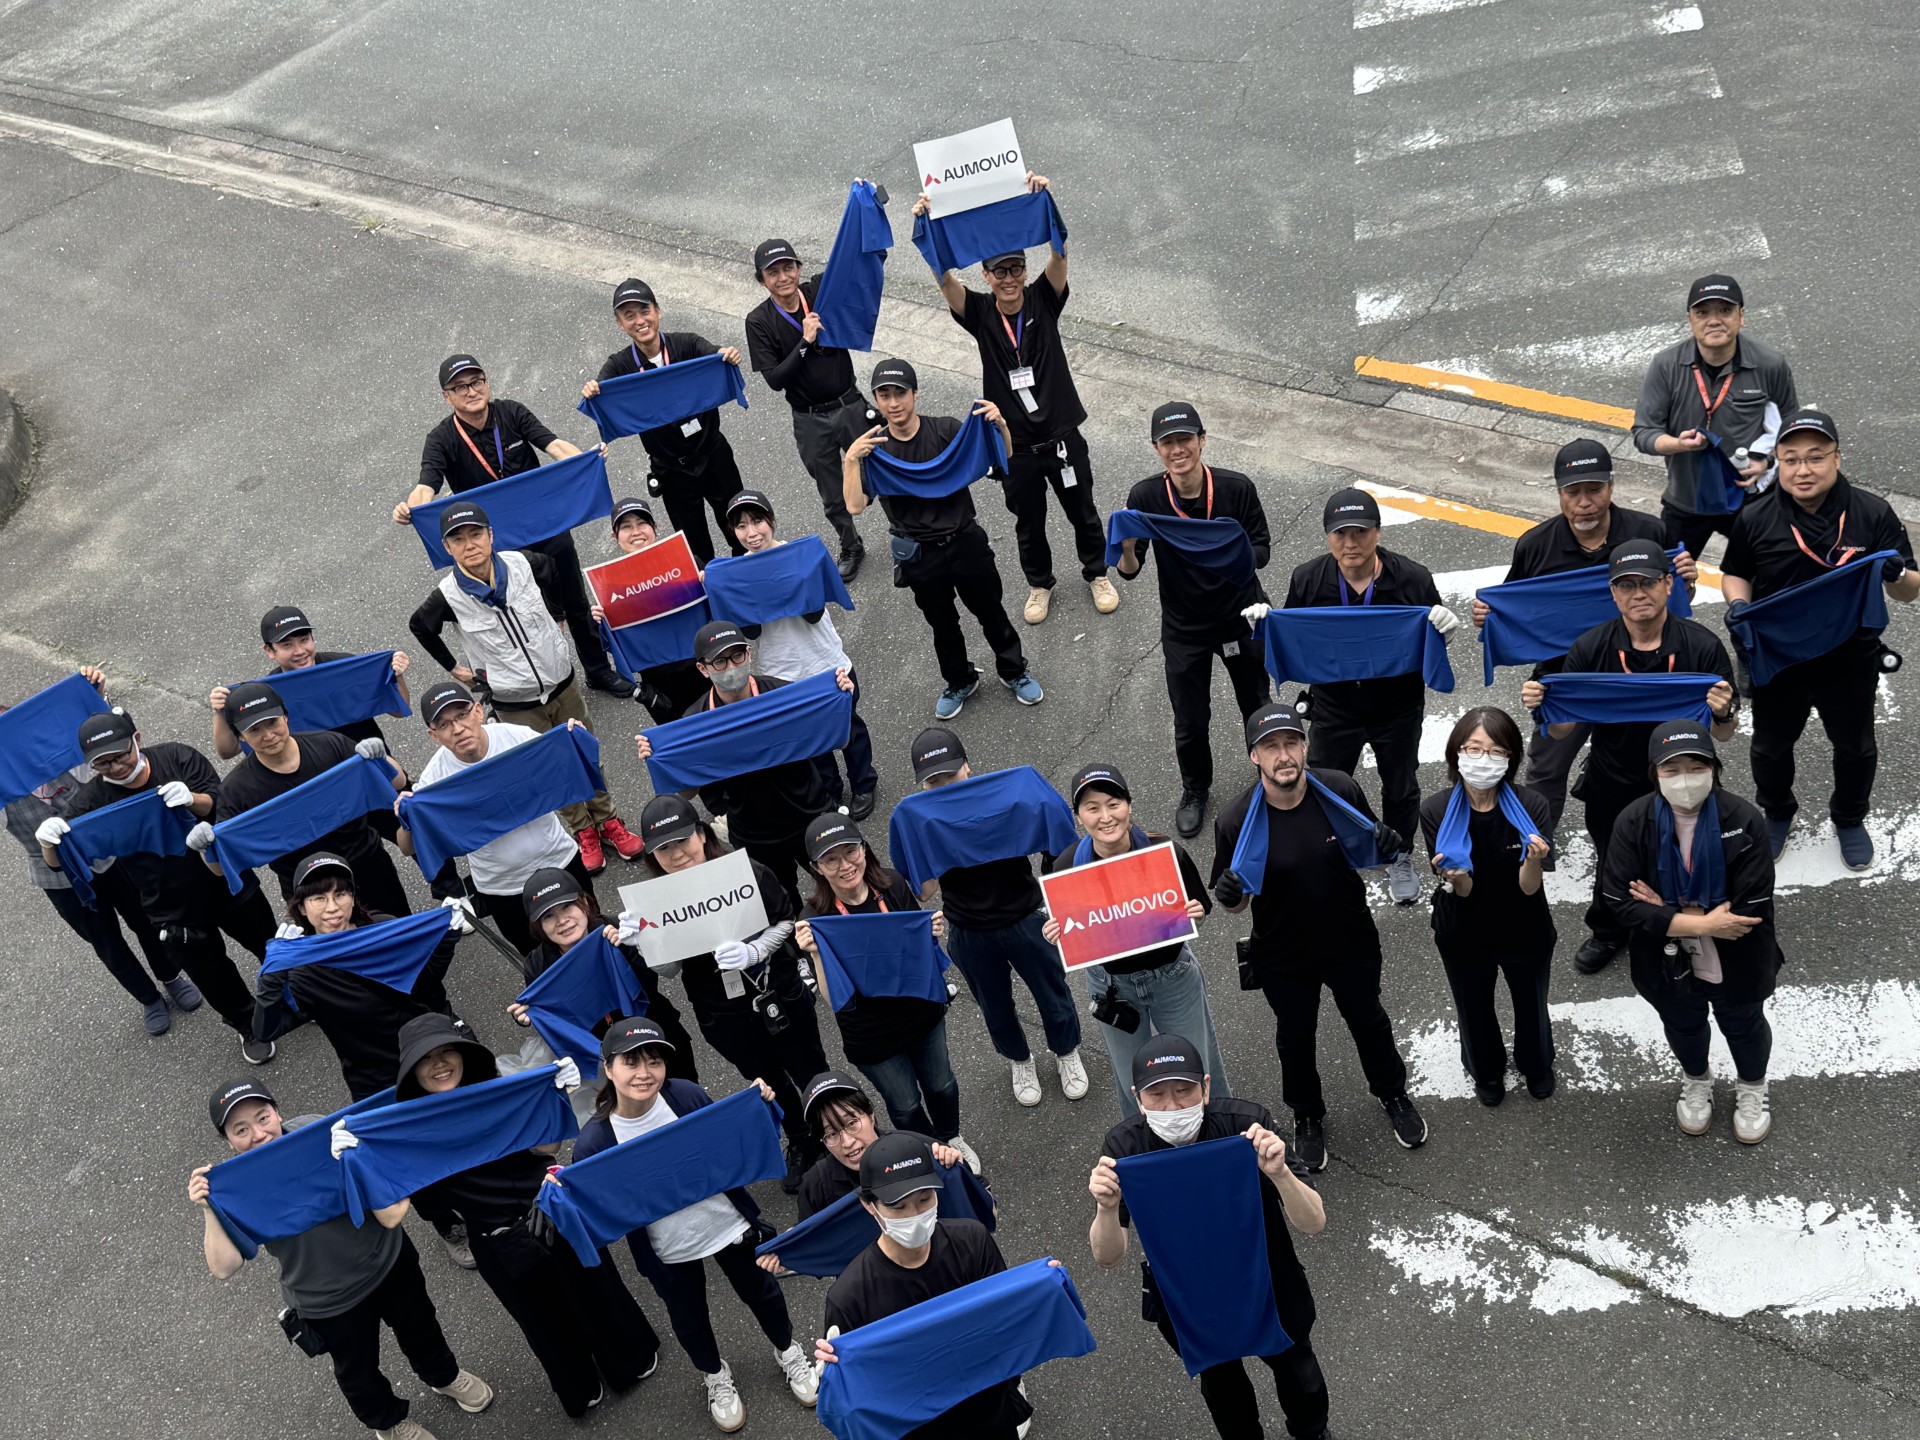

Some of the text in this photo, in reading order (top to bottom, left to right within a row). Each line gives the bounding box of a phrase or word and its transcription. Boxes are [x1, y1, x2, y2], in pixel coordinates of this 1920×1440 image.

[944, 150, 1018, 182] AUMOVIO
[625, 568, 681, 597] AUMOVIO
[662, 884, 754, 926] AUMOVIO
[1088, 889, 1178, 927] AUMOVIO
[1153, 1055, 1185, 1065] AUMOVIO
[892, 1157, 922, 1171] AUMOVIO
